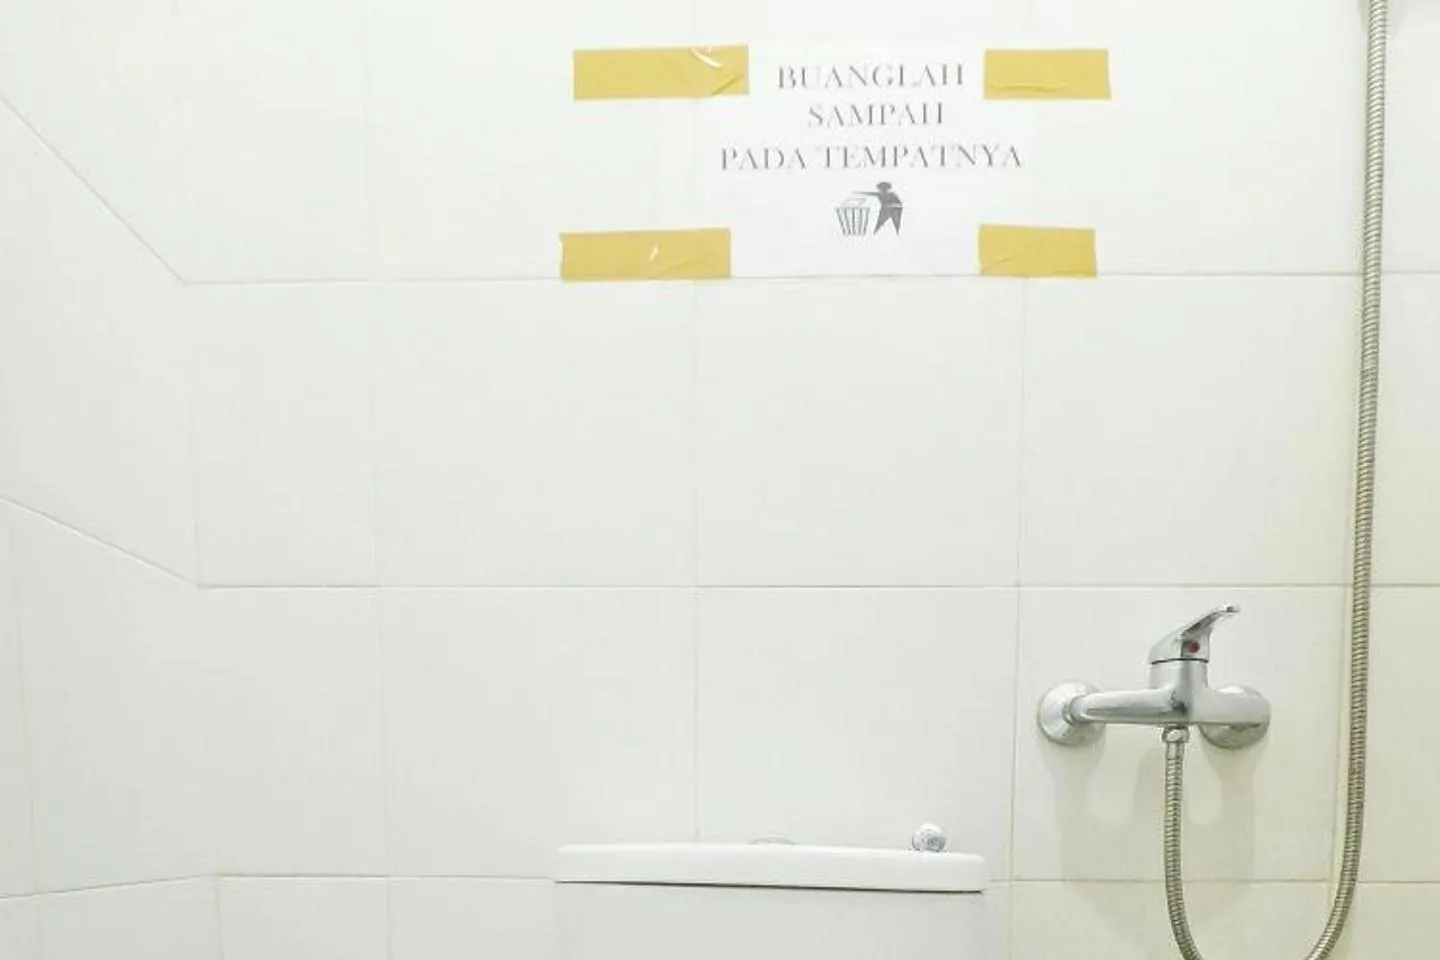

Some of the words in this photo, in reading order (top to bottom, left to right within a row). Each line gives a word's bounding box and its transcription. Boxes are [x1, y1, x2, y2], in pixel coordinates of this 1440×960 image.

[777, 63, 964, 90] BUANGLAH
[807, 101, 943, 128] SAMPAH
[720, 146, 808, 171] PADA
[821, 143, 1022, 169] TEMPATNYA
